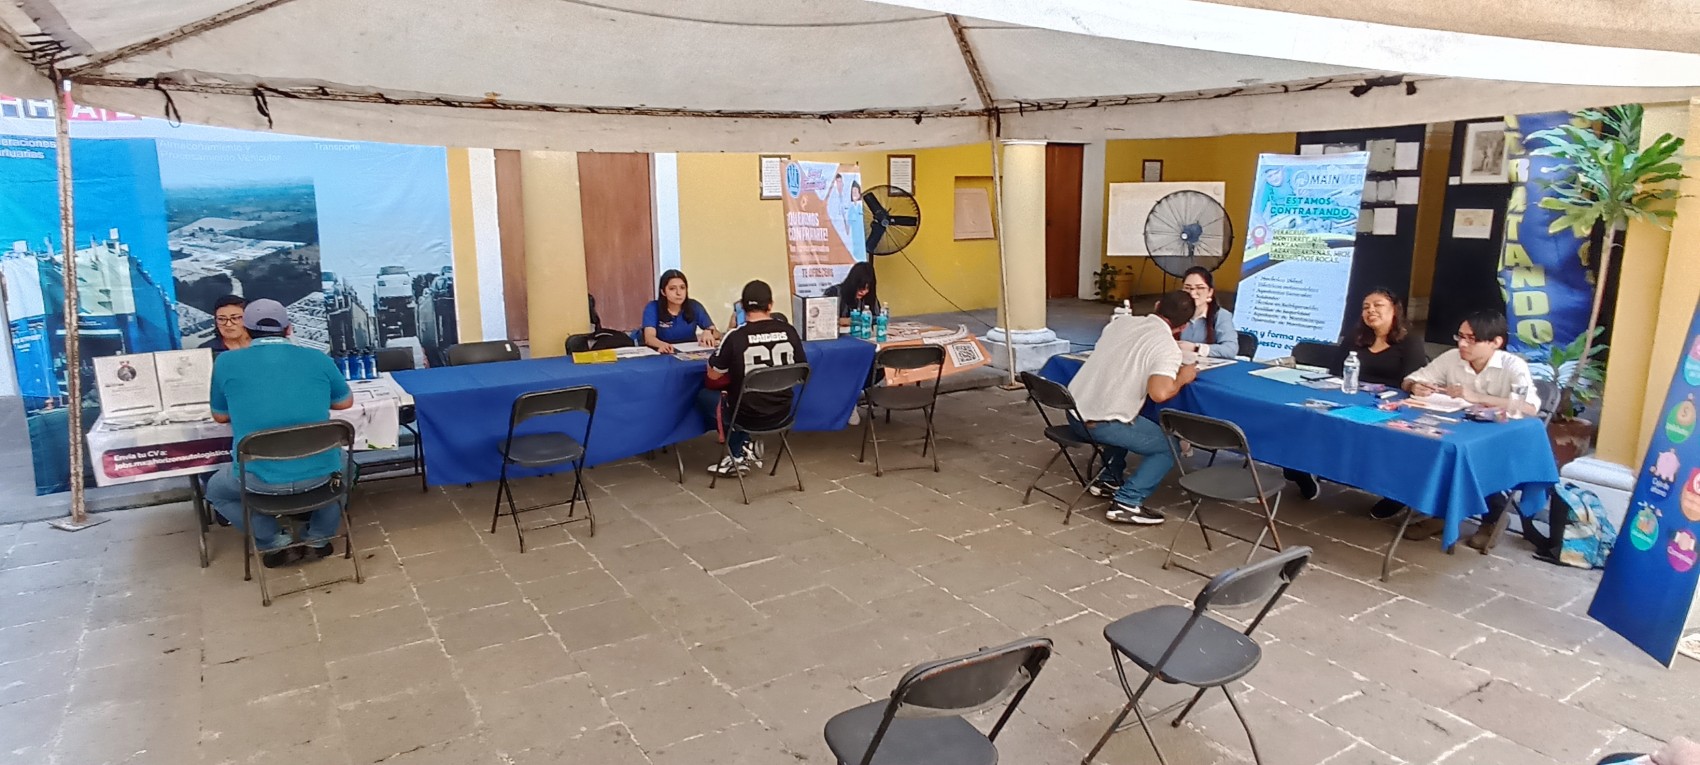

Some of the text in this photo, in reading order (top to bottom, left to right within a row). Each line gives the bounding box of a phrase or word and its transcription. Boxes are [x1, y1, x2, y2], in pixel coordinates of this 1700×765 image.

[0, 139, 56, 148] eraciones
[315, 142, 361, 151] Transporte
[0, 149, 45, 159] rtuarias
[1309, 174, 1363, 185] MAINVER
[1285, 196, 1331, 206] ESTAMOS
[1270, 206, 1350, 217] CONTRATANDO
[748, 332, 788, 344] RAIDERS
[1267, 330, 1294, 340] forma
[137, 452, 147, 461] tu
[147, 450, 159, 458] CV
